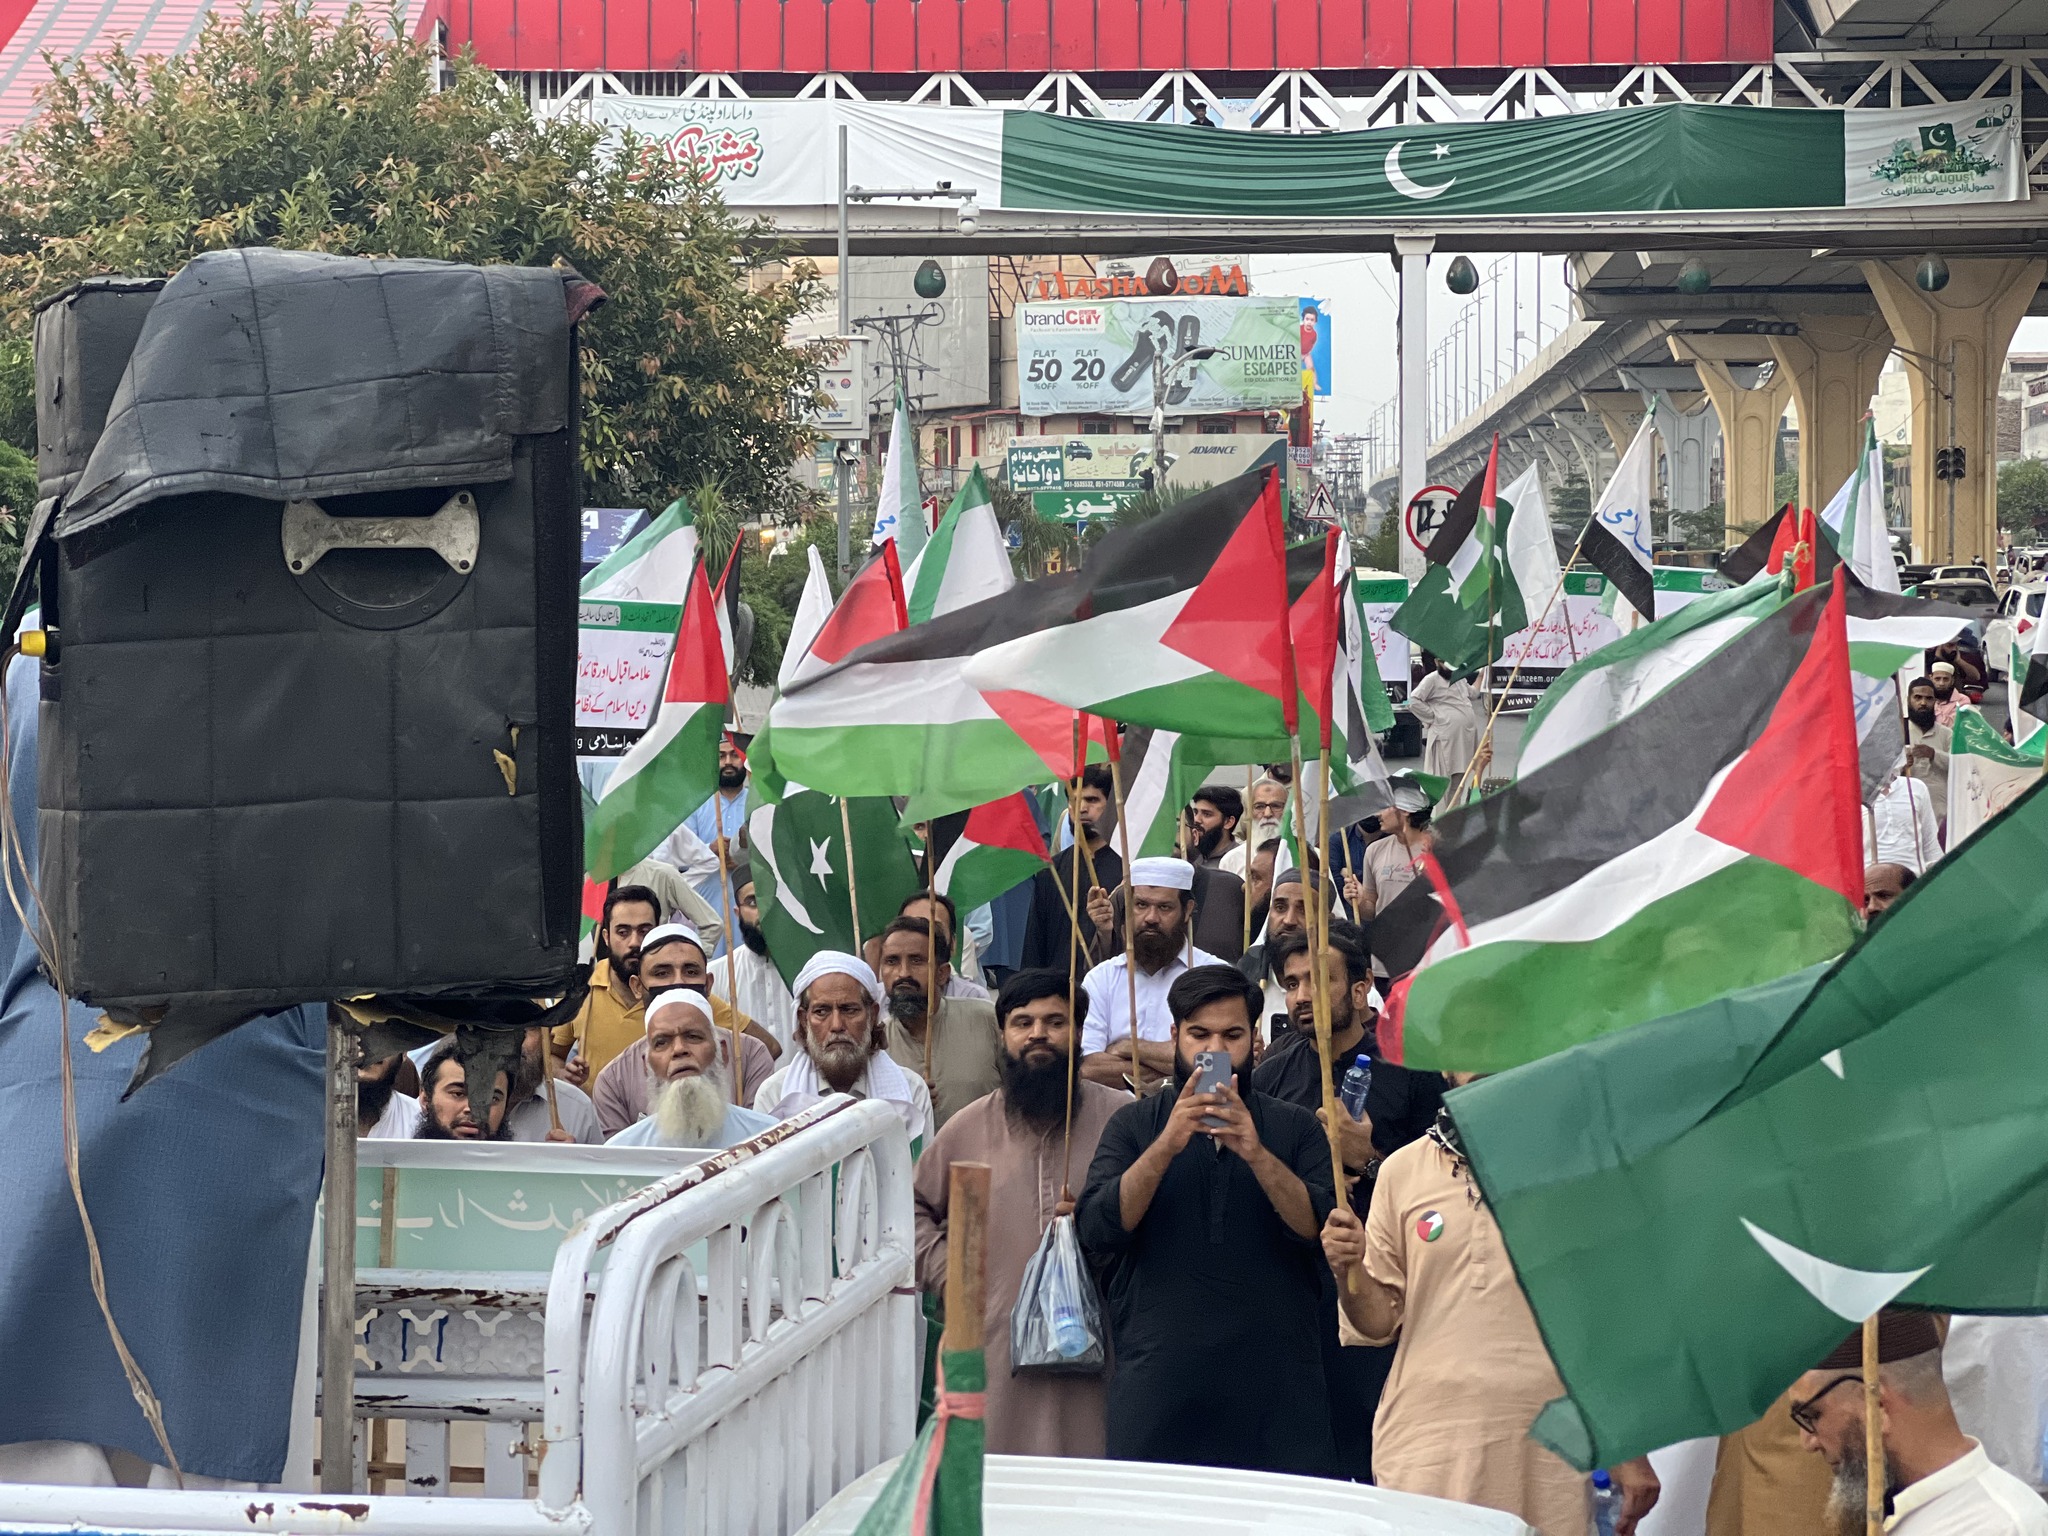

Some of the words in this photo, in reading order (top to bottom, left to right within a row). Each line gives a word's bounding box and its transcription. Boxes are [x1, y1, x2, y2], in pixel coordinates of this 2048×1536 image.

[1931, 172, 1975, 185] August
[1033, 349, 1057, 358] FLAT
[1075, 349, 1099, 357] FLAT
[1222, 344, 1296, 360] SUMMER
[1026, 358, 1062, 382] 50
[1070, 358, 1105, 382] 20
[1243, 361, 1297, 376] ESCAPES
[1076, 382, 1099, 390] %OFF
[1188, 446, 1238, 454] ADVANCE
